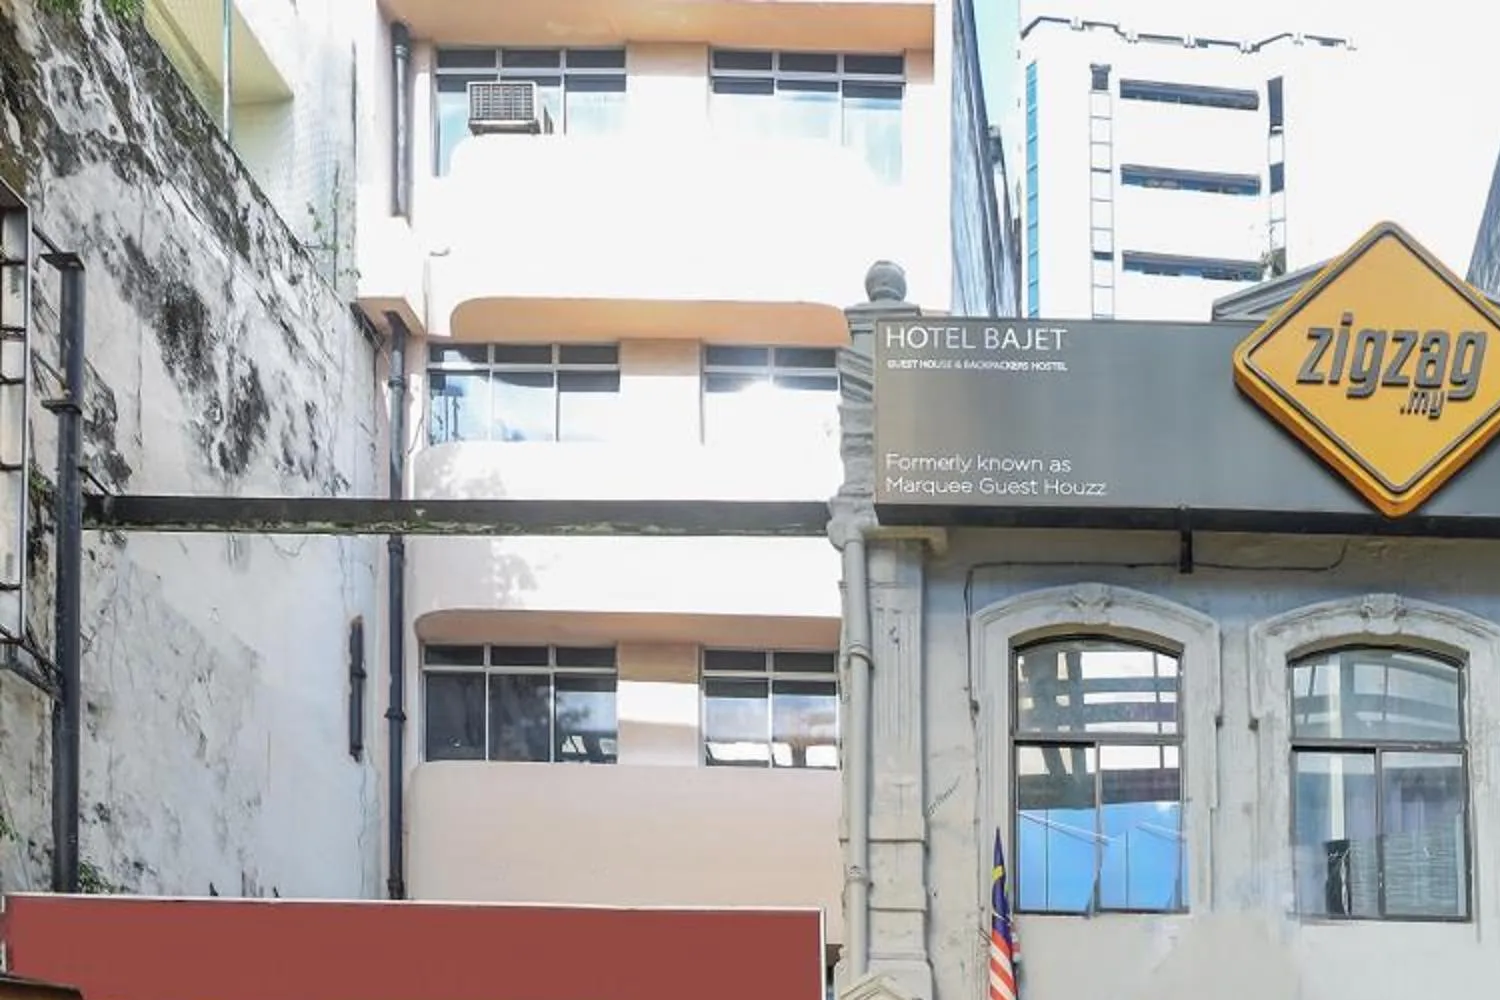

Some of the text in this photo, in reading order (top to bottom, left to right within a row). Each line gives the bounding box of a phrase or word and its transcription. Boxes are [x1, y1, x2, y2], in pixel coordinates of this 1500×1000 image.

[886, 326, 1068, 351] HOTEL BAJET
[887, 359, 918, 370] GUEST
[919, 359, 952, 370] HOUSE
[1031, 361, 1068, 372] HOSTEL
[1296, 311, 1487, 402] zigzag
[886, 454, 1072, 475] Formerly known as
[886, 477, 1107, 497] Marquee Guest Houzz
